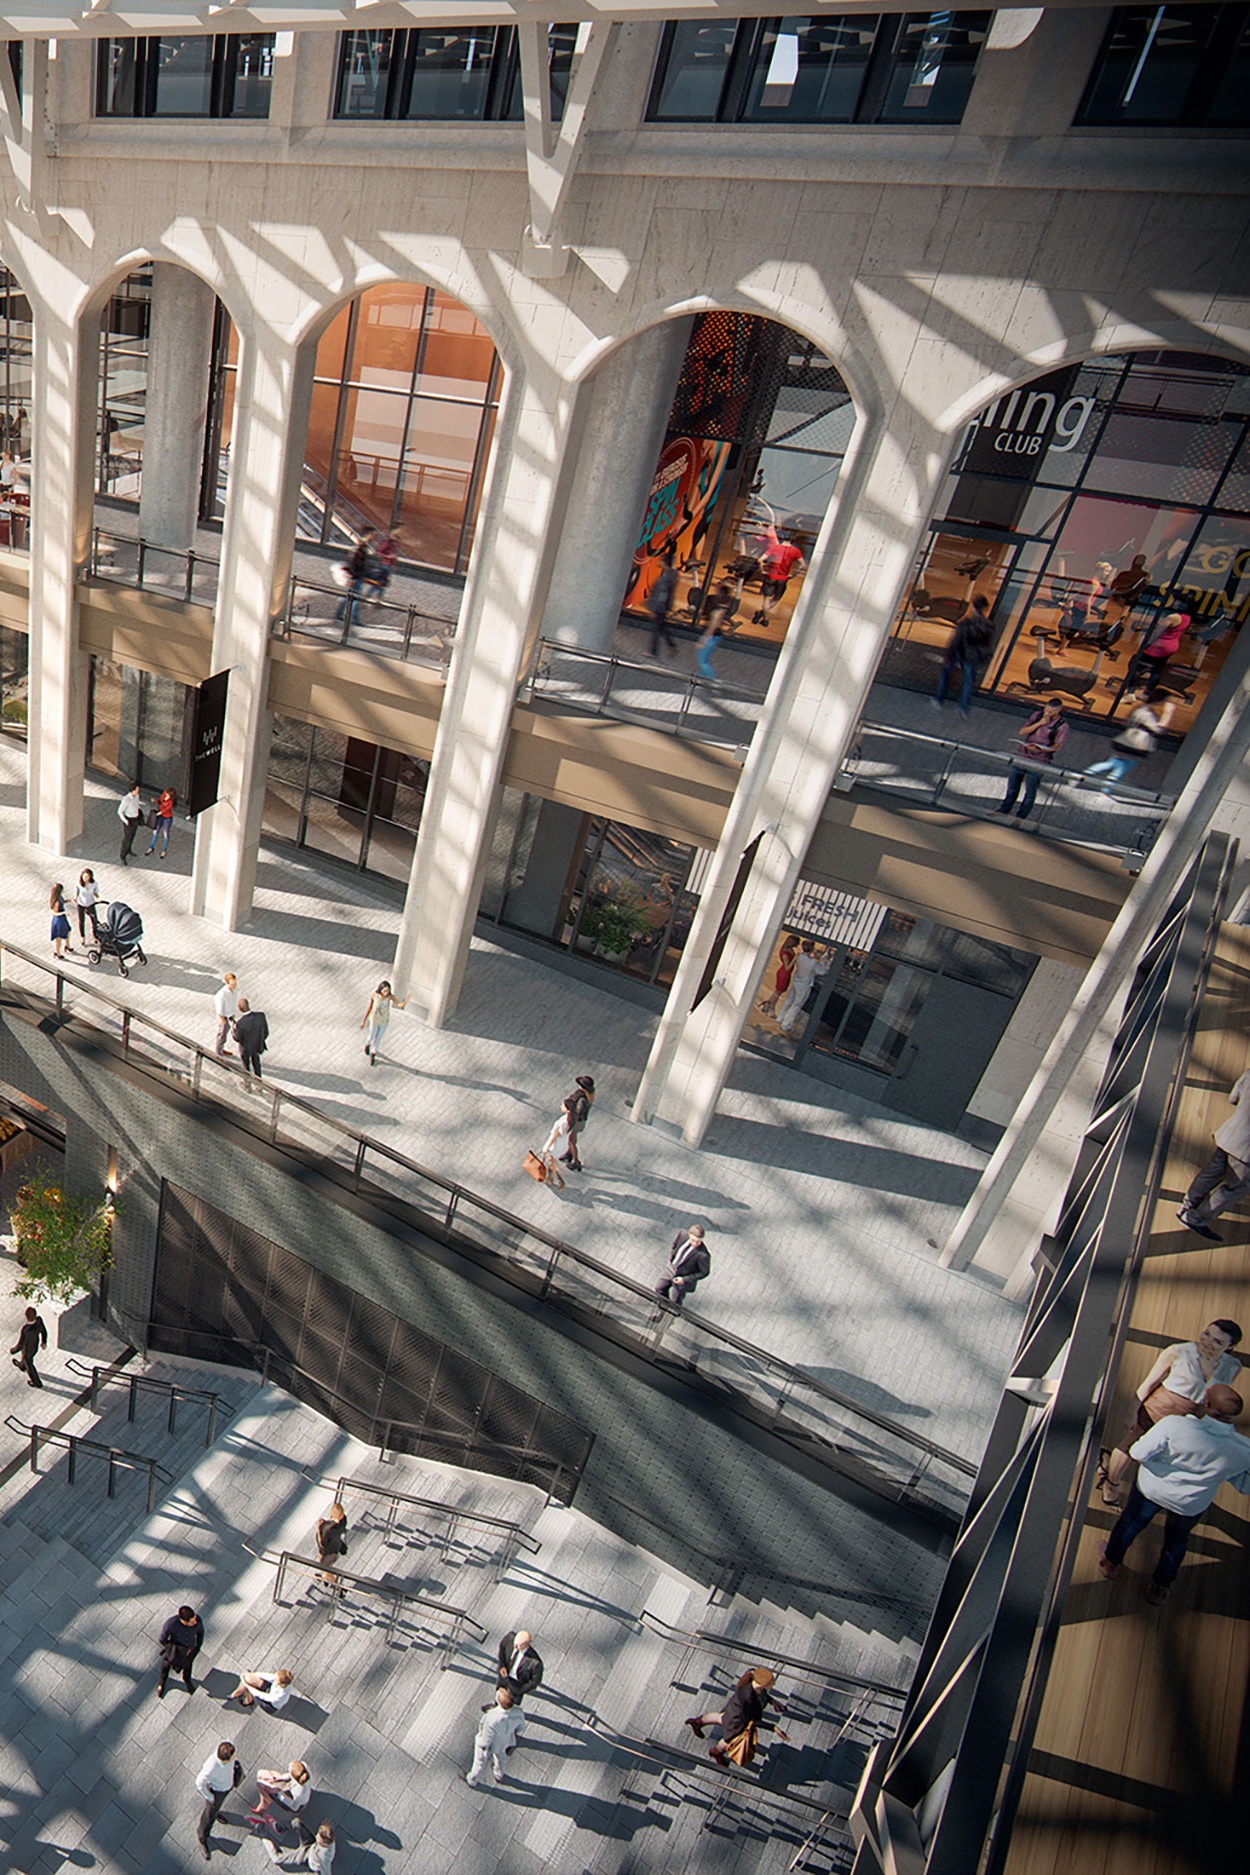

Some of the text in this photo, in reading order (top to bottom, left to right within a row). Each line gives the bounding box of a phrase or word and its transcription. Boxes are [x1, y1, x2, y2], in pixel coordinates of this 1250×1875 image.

[994, 432, 1042, 455] CLUB
[636, 498, 679, 548] CLASS
[786, 906, 832, 929] juices
[801, 894, 859, 923] FRESH
